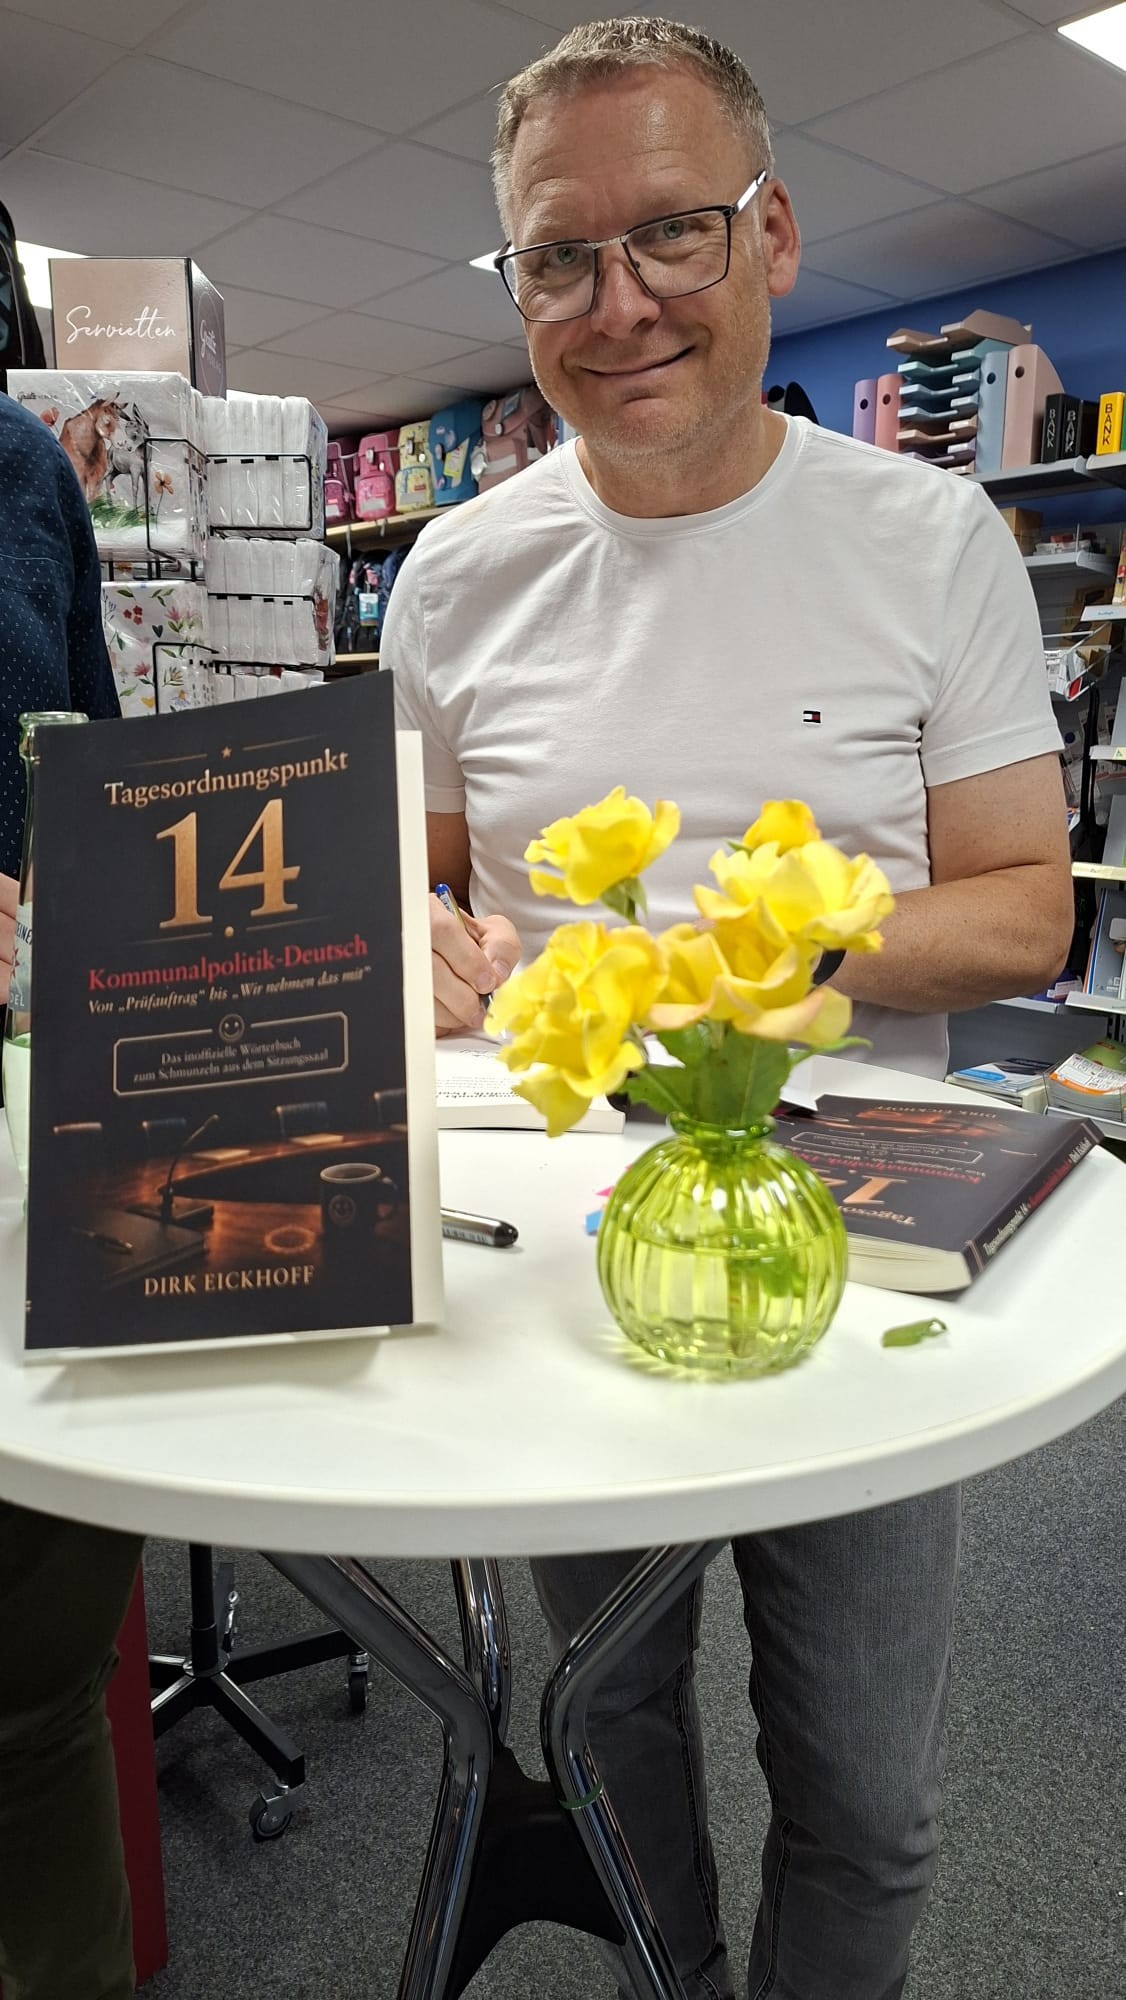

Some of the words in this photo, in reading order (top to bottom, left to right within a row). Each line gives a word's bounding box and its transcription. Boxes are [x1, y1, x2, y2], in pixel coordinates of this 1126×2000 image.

[66, 305, 176, 343] Servietten
[1046, 408, 1056, 448] BANK
[1065, 410, 1076, 453] BANK
[1102, 403, 1113, 446] BANK
[104, 748, 349, 808] Tagesordnungspunkt
[156, 798, 301, 929] 14
[88, 933, 368, 992] Kommunalpolitik-Deutsch
[89, 1000, 114, 1015] Von
[209, 986, 228, 1001] bis
[266, 976, 315, 994] nehmen
[317, 970, 339, 988] das
[133, 1072, 156, 1083] zum
[158, 1065, 220, 1081] Schmunzeln
[223, 1062, 240, 1073] aus
[242, 1058, 265, 1072] dem
[161, 1052, 182, 1065] Das
[184, 1045, 238, 1063] inoffizielle
[144, 1274, 197, 1297] DIRK
[204, 1264, 315, 1292] EICKHOFF
